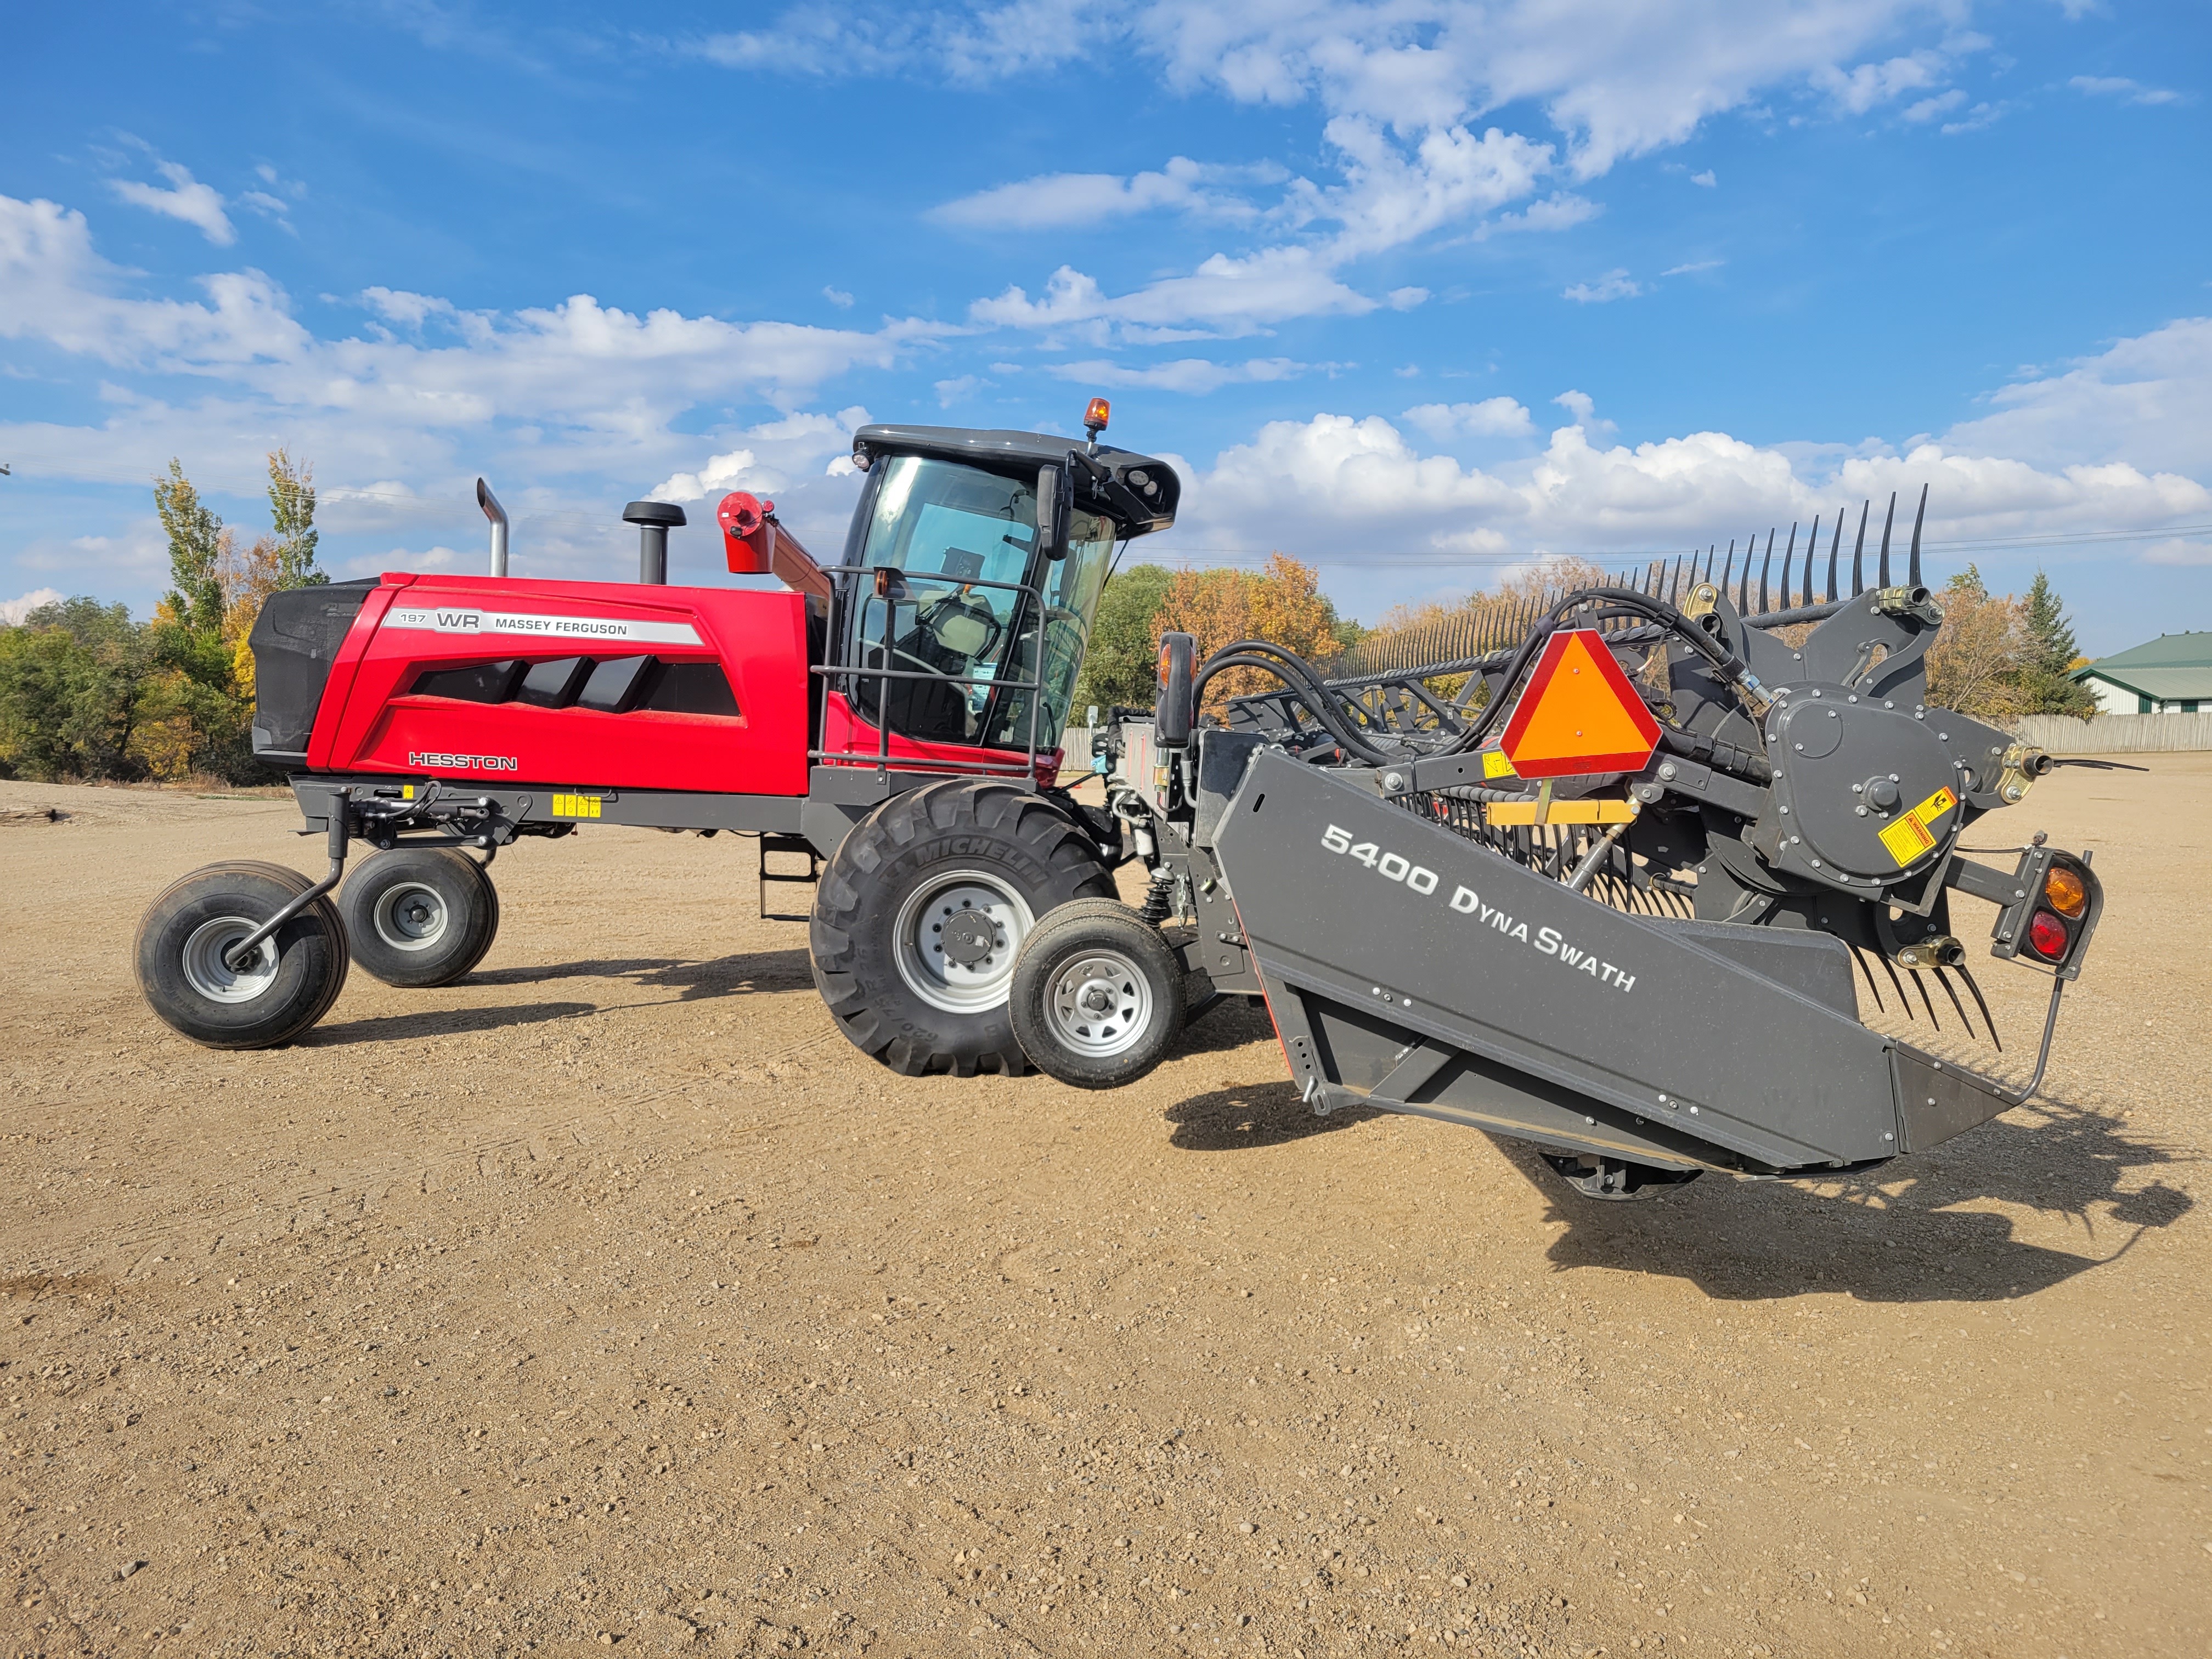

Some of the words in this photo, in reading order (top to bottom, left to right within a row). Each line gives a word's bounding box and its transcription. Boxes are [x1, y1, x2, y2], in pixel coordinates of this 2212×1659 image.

[399, 613, 426, 623] 197
[437, 613, 479, 628] WR
[495, 618, 551, 631] MASSEY
[556, 622, 628, 635] FERGUSON
[409, 752, 517, 770] HESSTON
[1913, 822, 1929, 844] WARNING
[915, 838, 1048, 884] MICHELIN
[1321, 823, 1439, 896] 5400
